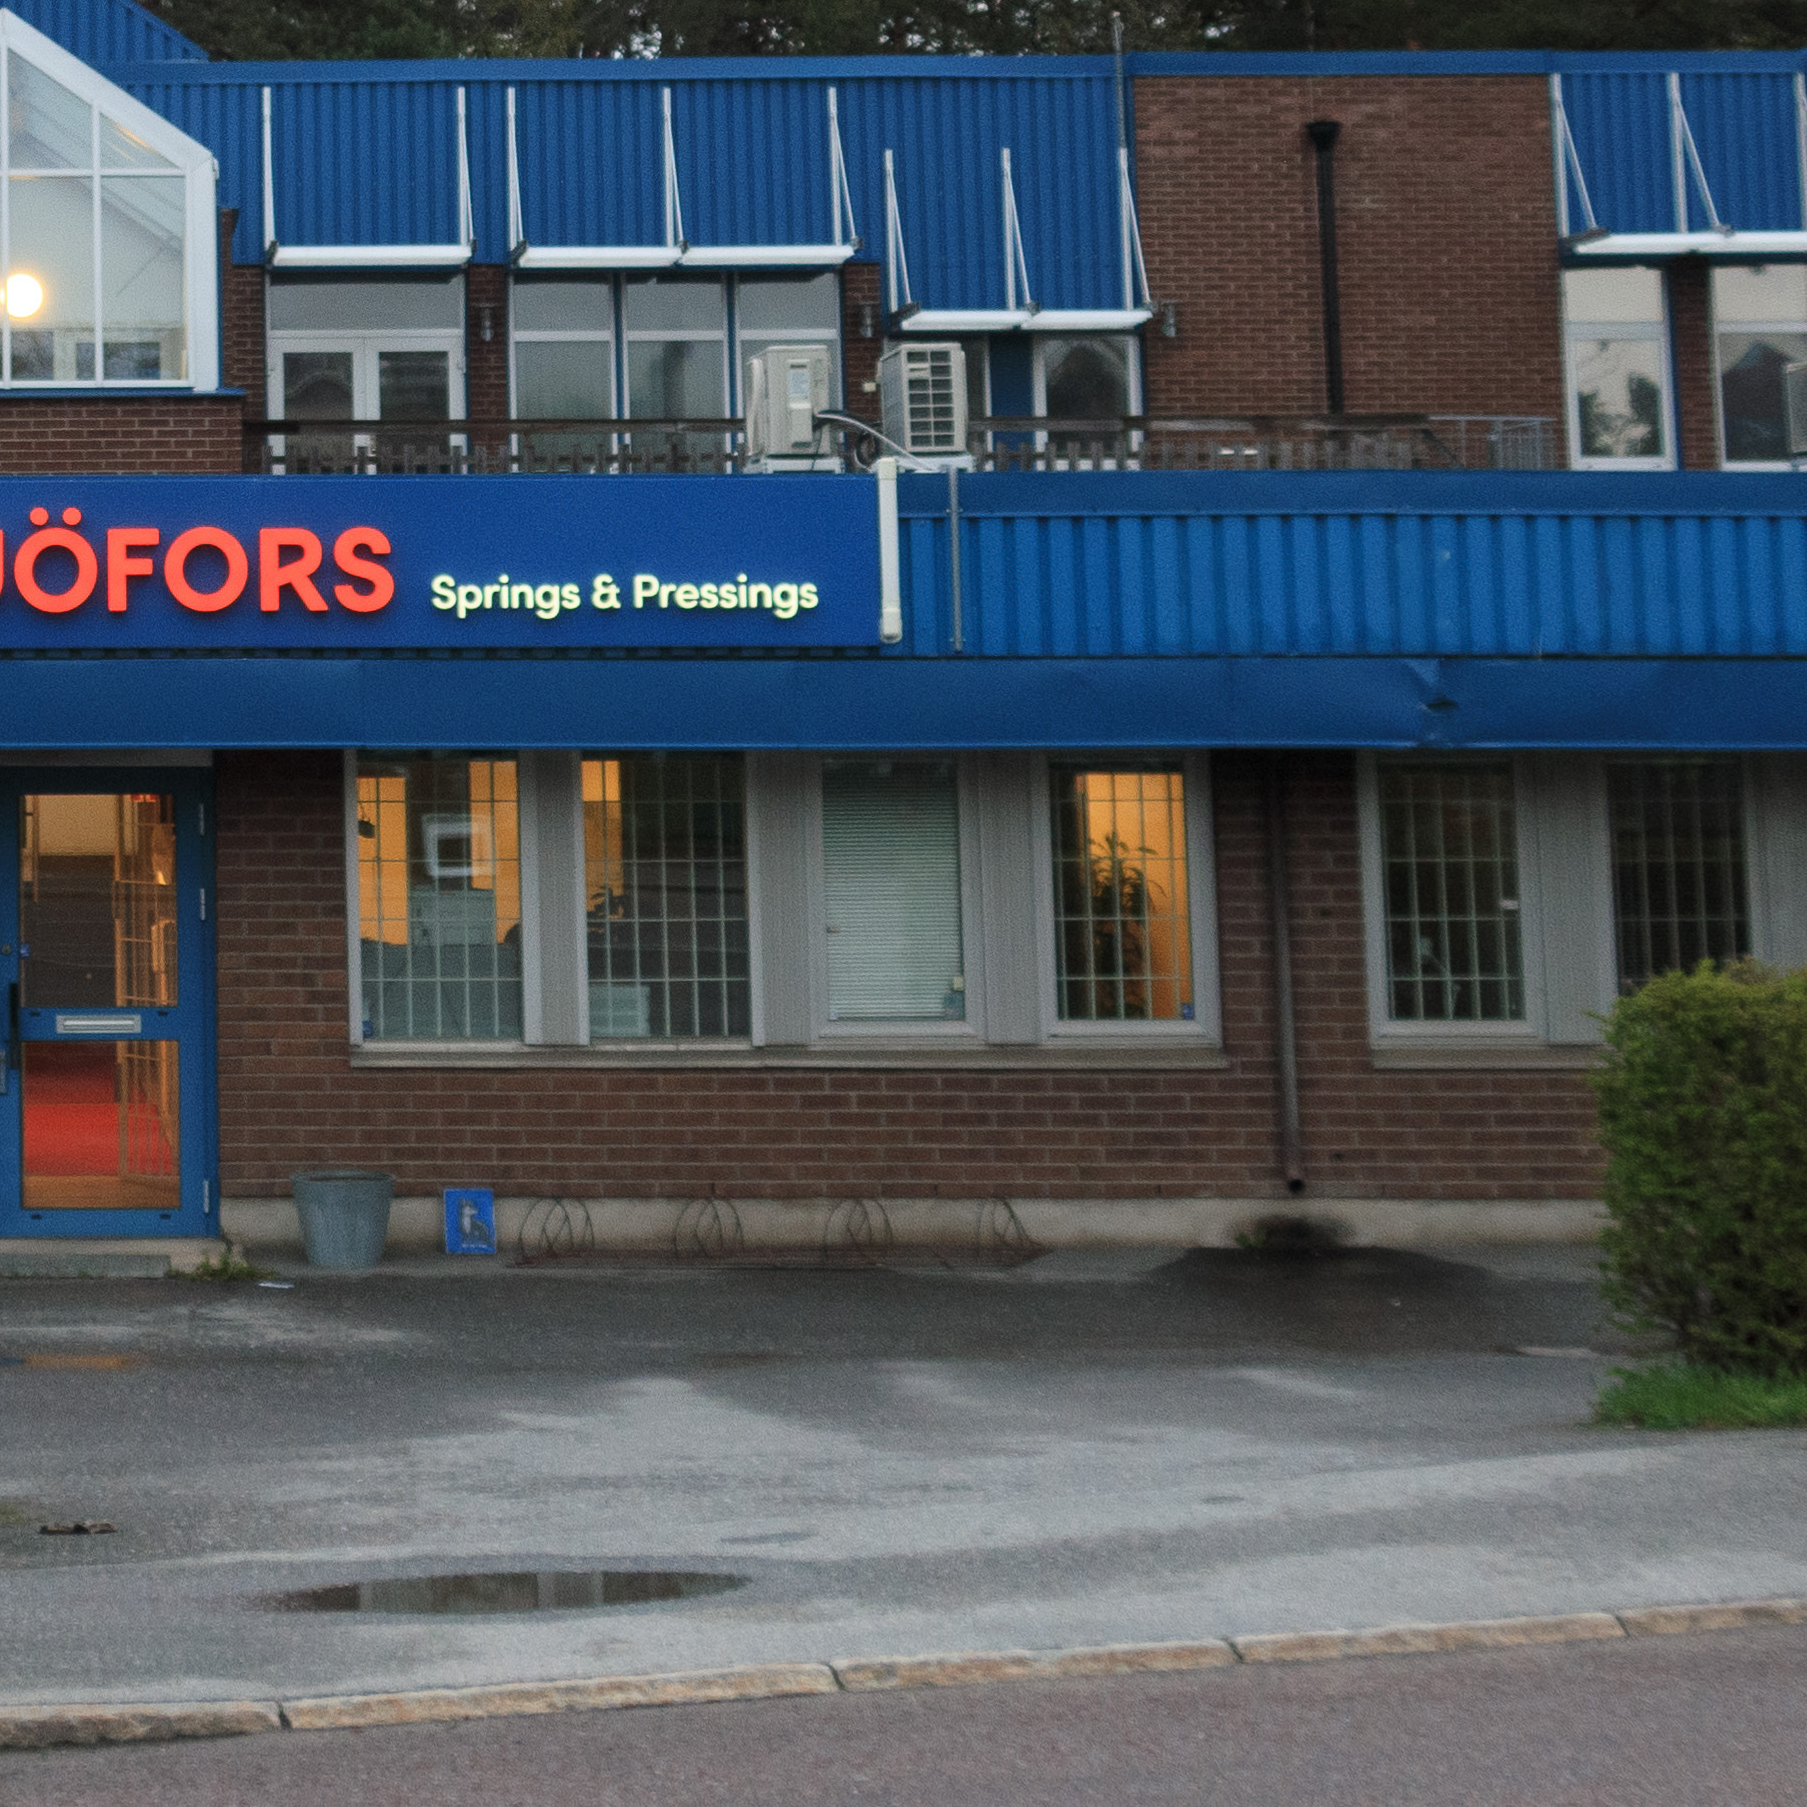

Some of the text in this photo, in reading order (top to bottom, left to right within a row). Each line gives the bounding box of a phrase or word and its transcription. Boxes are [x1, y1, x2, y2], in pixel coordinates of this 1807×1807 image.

[430, 573, 581, 619] Springs
[590, 573, 622, 609] &
[633, 573, 819, 619] Pressings
